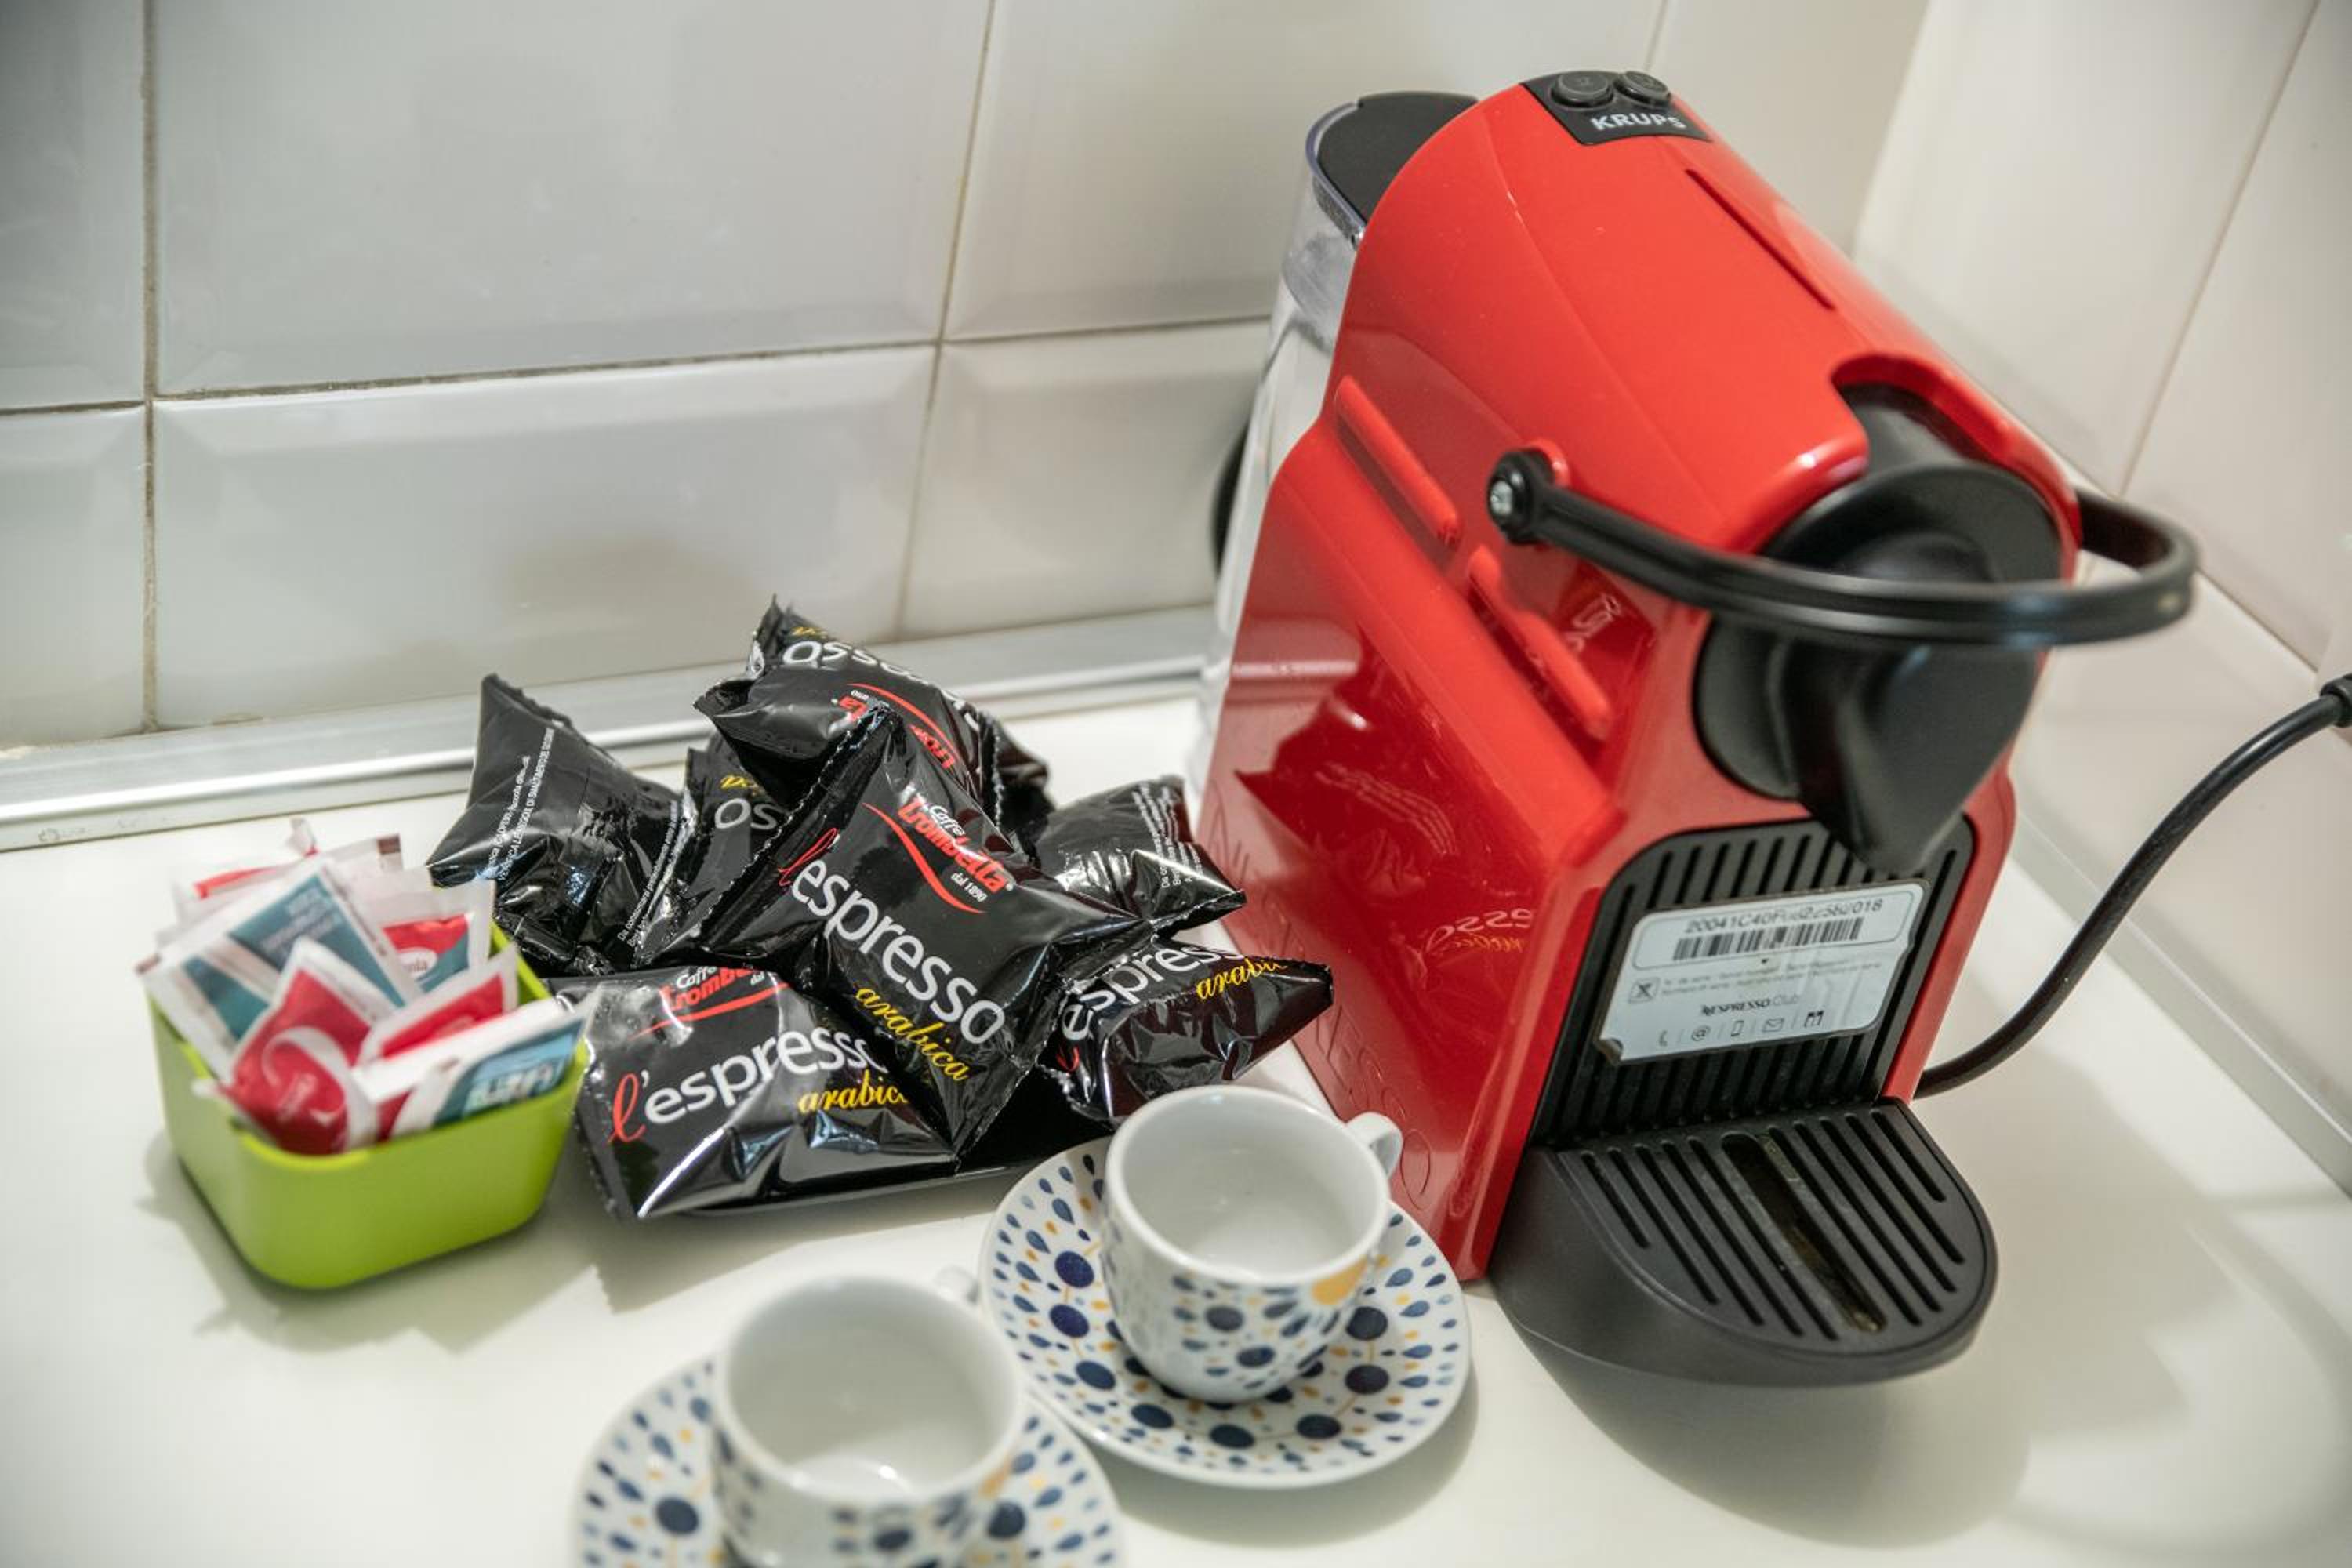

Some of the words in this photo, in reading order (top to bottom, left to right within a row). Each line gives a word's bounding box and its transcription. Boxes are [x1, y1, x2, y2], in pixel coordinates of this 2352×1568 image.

[1590, 112, 1687, 131] KRUPS
[964, 882, 988, 902] 1890
[853, 984, 970, 1081] arabica
[797, 1068, 909, 1115] arabic
